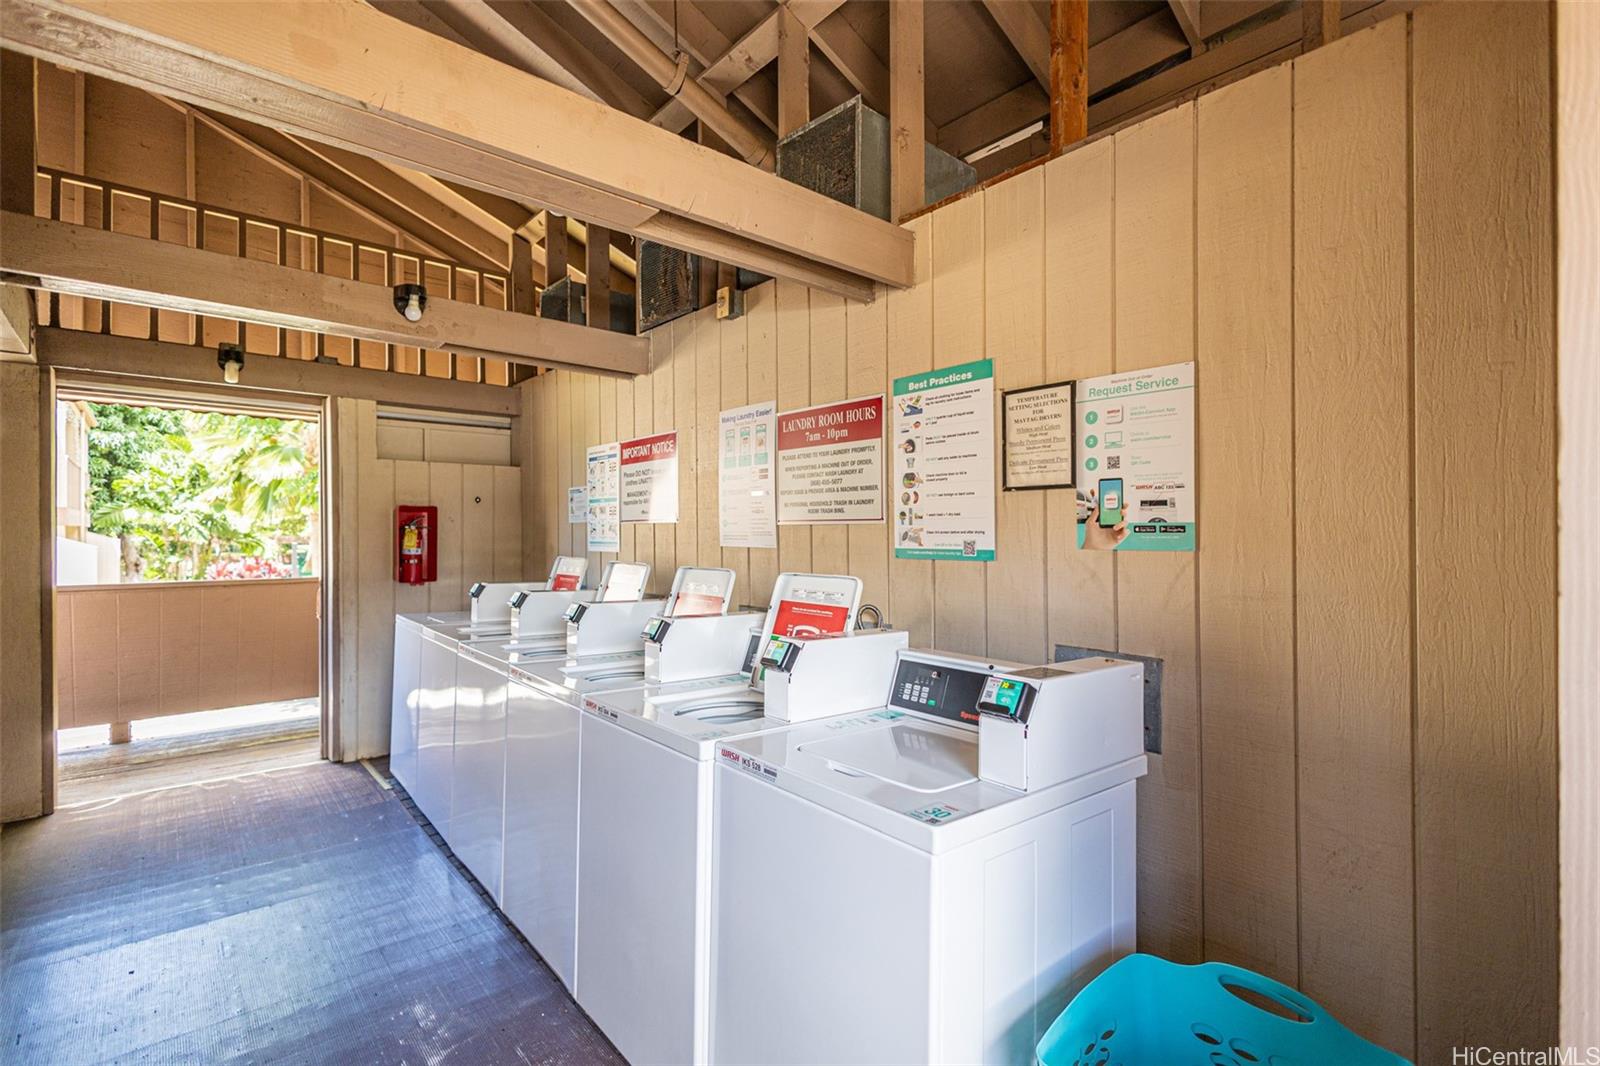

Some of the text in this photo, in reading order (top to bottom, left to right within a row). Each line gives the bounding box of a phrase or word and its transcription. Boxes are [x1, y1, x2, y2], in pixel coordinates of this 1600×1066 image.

[908, 371, 973, 391] Best Practices
[1088, 376, 1179, 398] Request Service
[1008, 398, 1068, 411] SETTING SELECTIONS
[1017, 392, 1058, 404] TEMPERATURE
[721, 415, 736, 425] Making
[737, 412, 755, 421] Laundry
[783, 406, 876, 433] LAUNDRY ROOM HOURS
[1014, 416, 1039, 424] MAYTAG
[1017, 423, 1061, 433] Whites and Colors
[805, 432, 821, 442] 7am
[827, 428, 848, 440] 10pm
[623, 440, 674, 459] IMPORTANT NOTICE
[830, 448, 850, 456] LAUNDRY
[642, 468, 650, 476] NOT
[837, 468, 857, 476] LAUNDRY
[721, 748, 740, 762] WASH
[752, 761, 761, 772] 528
